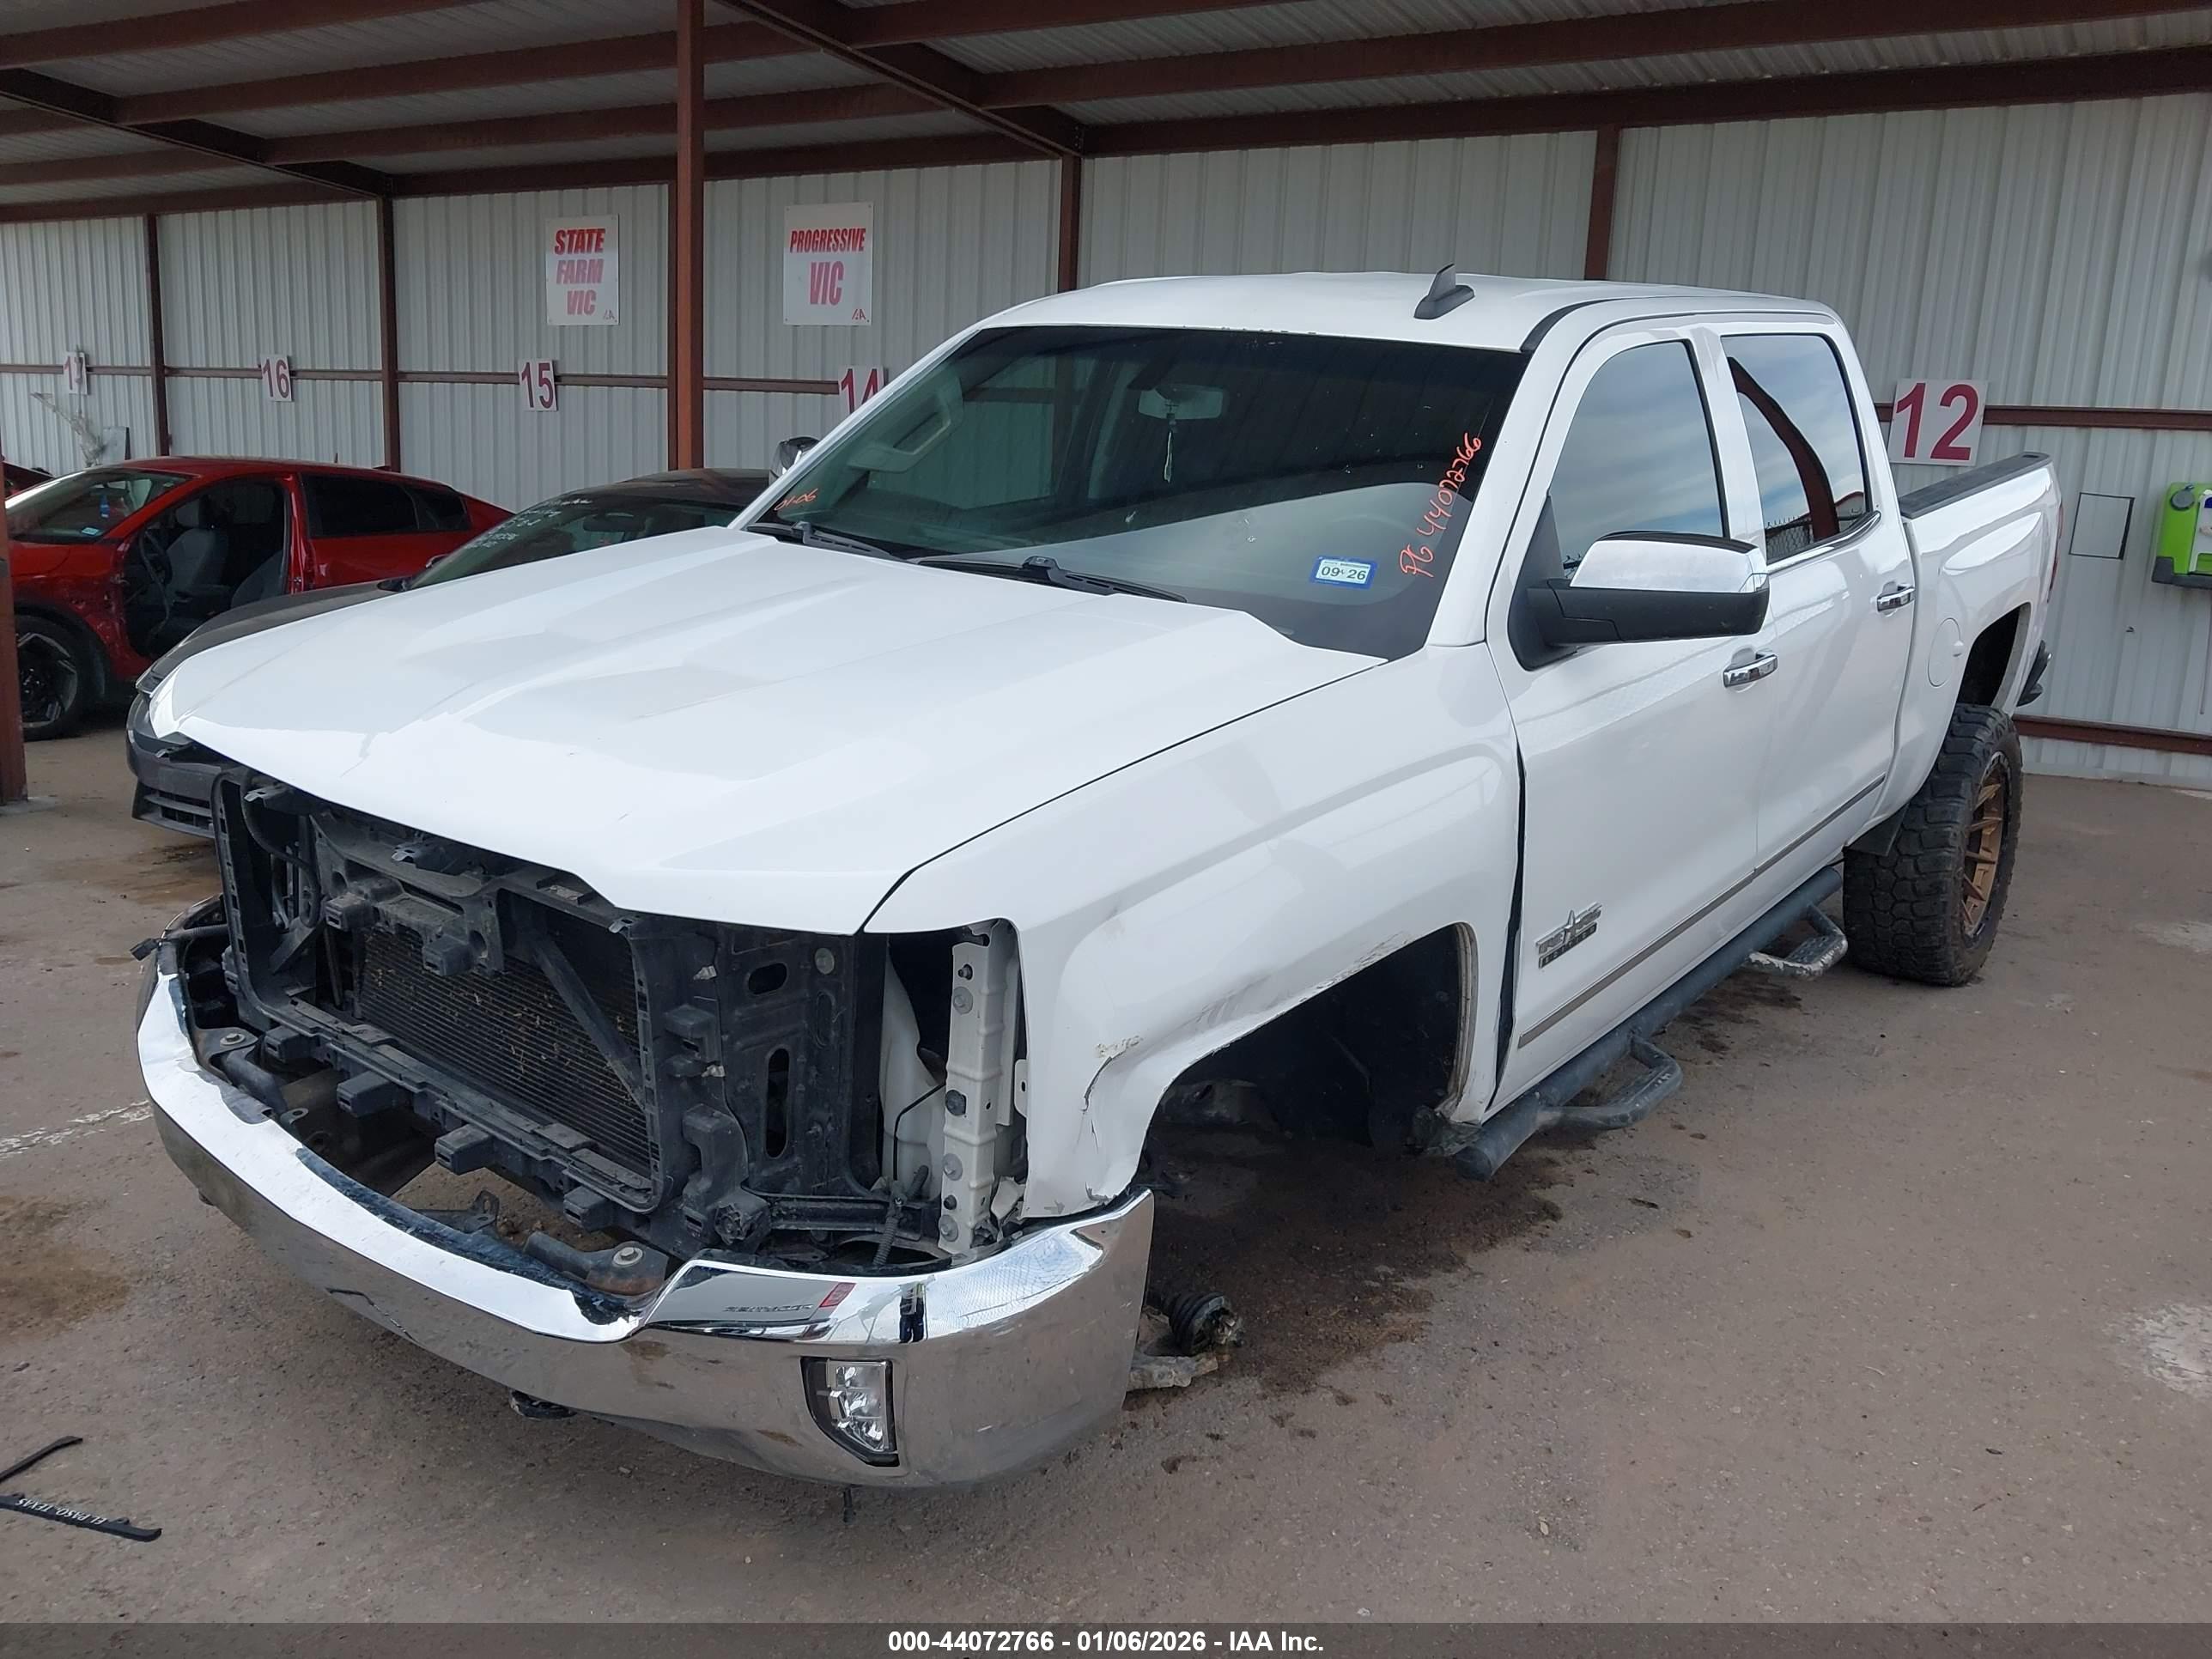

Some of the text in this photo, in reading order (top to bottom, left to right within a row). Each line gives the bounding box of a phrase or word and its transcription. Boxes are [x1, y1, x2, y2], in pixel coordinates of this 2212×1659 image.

[555, 228, 606, 256] STATE
[789, 228, 866, 253] PROGRESSIVE
[556, 258, 605, 285] FARM
[809, 260, 845, 307] VIC
[567, 289, 597, 316] VIC
[261, 358, 290, 399] 16
[520, 362, 554, 410] 15
[1894, 382, 1979, 461] 12
[1417, 432, 1482, 536] 44072766
[1321, 566, 1367, 580] 09 26
[15, 1498, 52, 1511] TEXAS
[89, 1513, 107, 1524] EL
